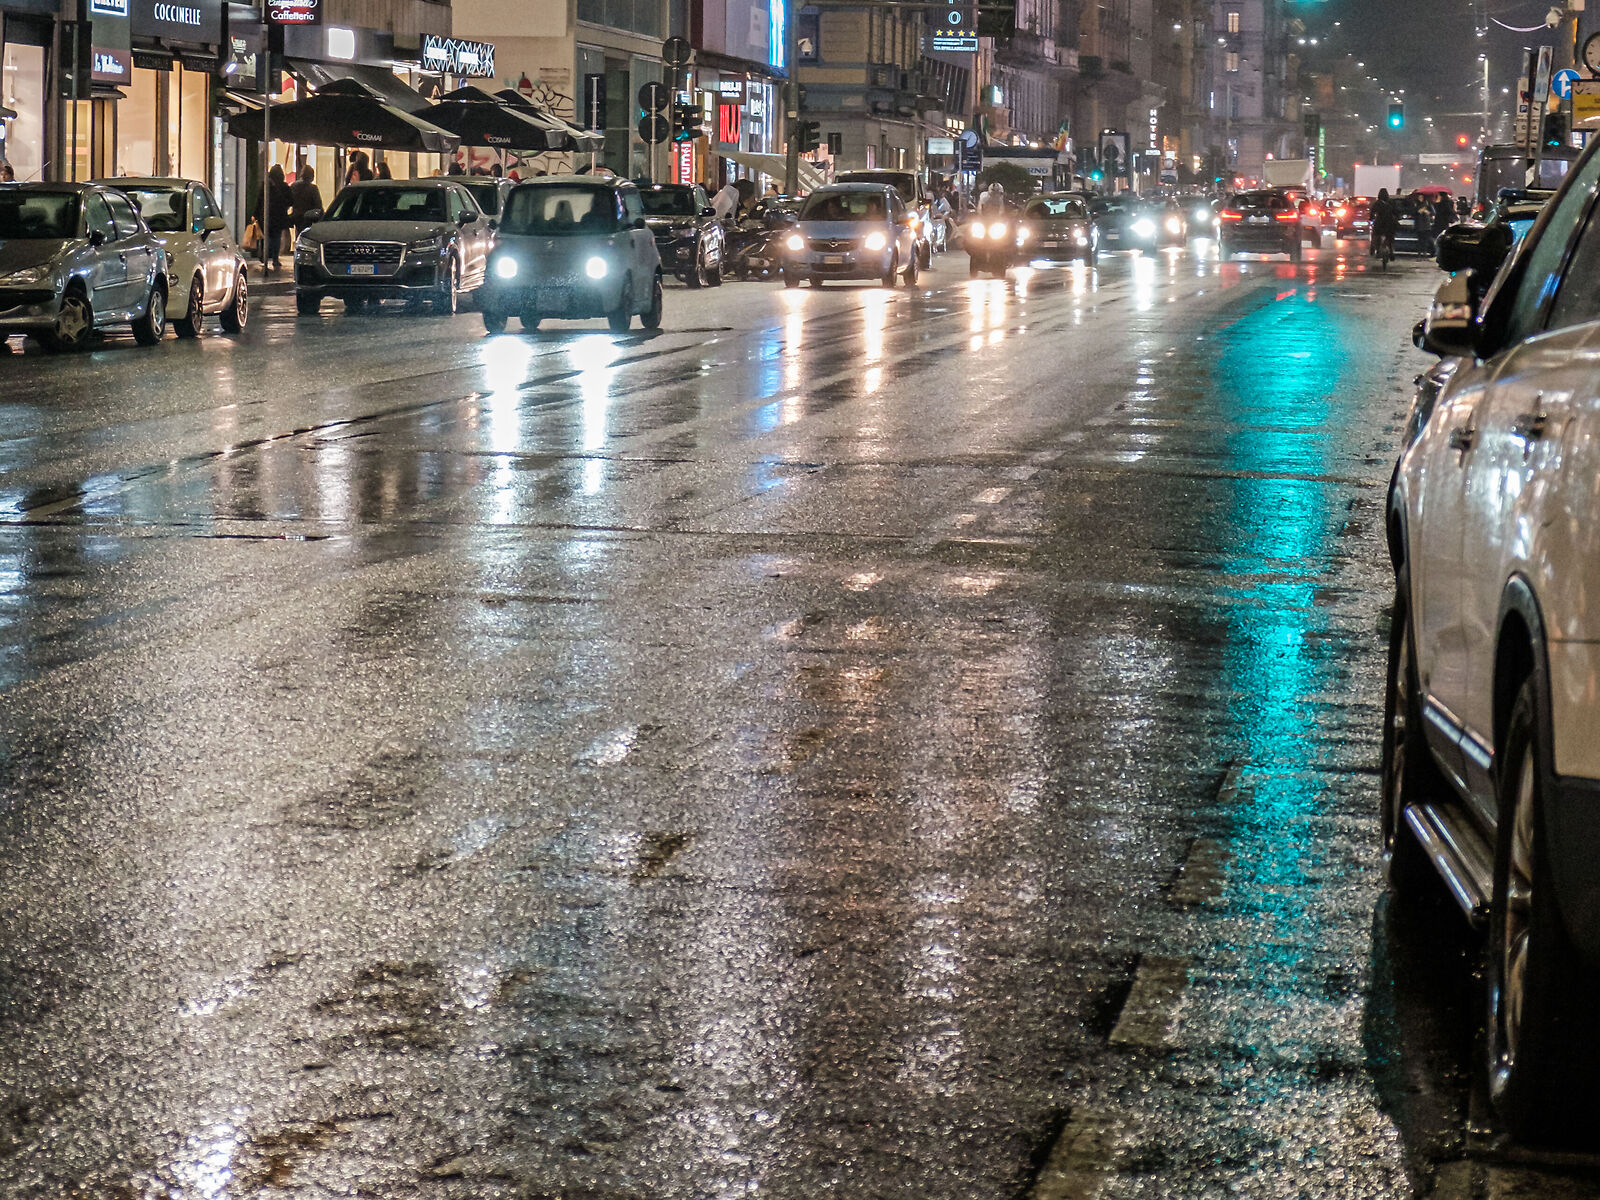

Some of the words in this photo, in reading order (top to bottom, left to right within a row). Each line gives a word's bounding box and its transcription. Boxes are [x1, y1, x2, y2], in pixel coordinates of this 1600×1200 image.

[154, 3, 201, 25] COCCINELLE
[271, 10, 314, 21] Caffetteria
[1149, 109, 1158, 148] HOTEL
